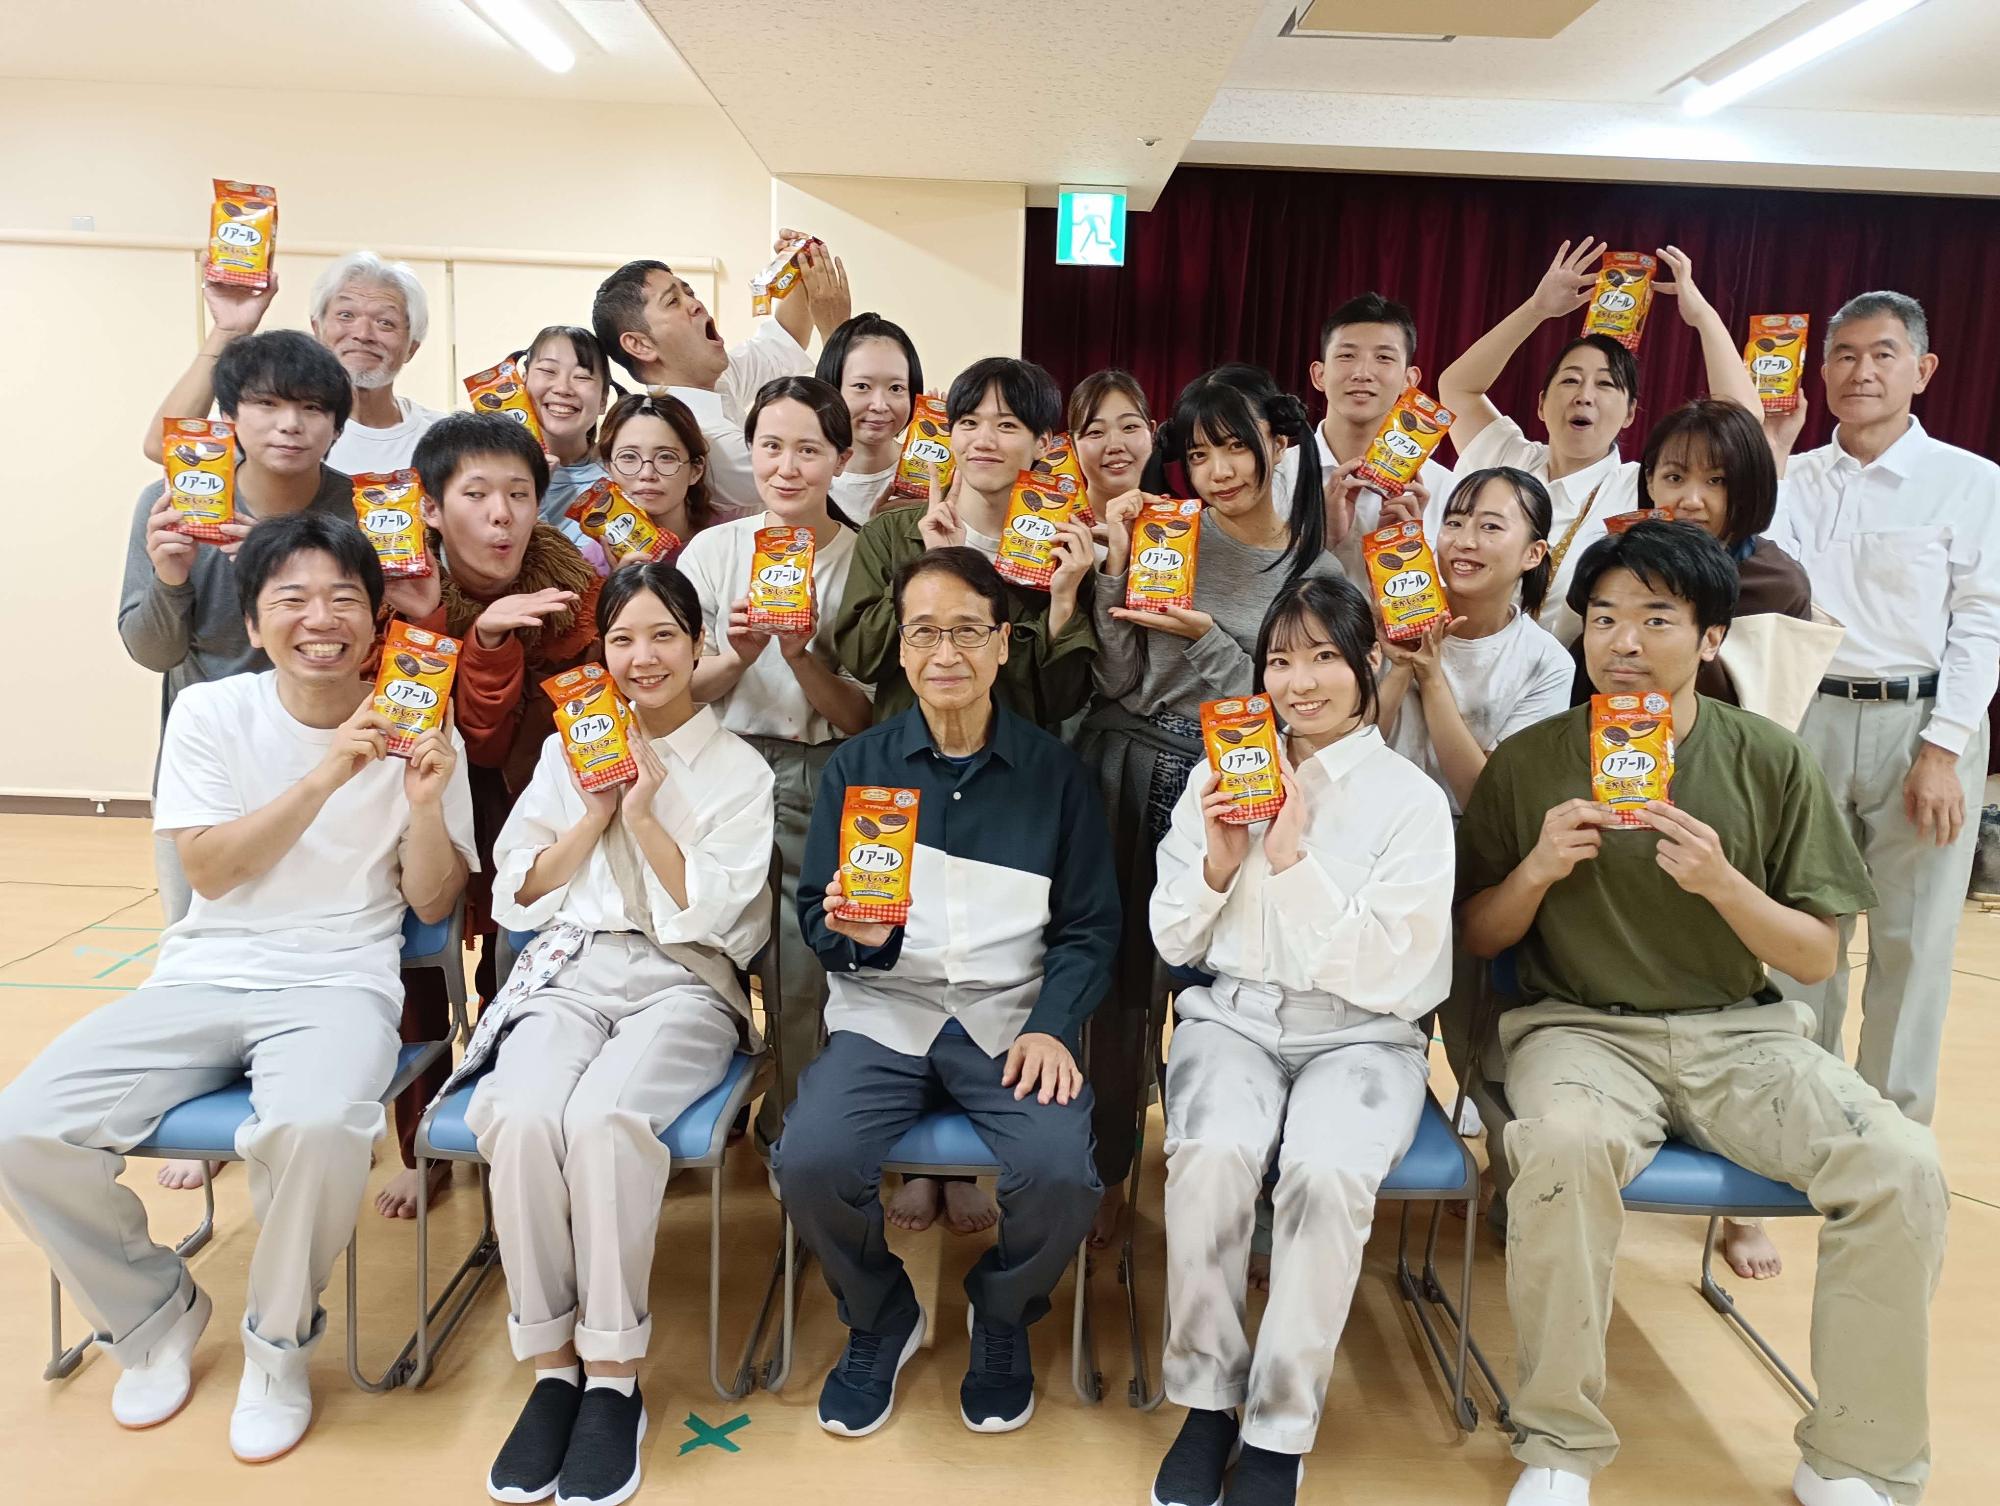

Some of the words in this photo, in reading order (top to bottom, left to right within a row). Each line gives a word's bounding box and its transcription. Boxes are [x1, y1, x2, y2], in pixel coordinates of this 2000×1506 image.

[222, 227, 257, 242] ノアール
[1603, 294, 1633, 308] ノアール
[914, 443, 947, 460] ノアール
[1387, 435, 1418, 456] ノアール
[180, 475, 220, 490] ノアール
[369, 514, 409, 528] ノアール
[1016, 518, 1053, 537] ノアール
[1144, 552, 1180, 566] ノアール
[764, 569, 801, 581] ノアール
[1391, 574, 1427, 594] ノアール
[391, 685, 434, 704] ノアール
[575, 718, 610, 740] ノアール
[1227, 751, 1266, 769] ノアール
[1607, 756, 1651, 772] ノアール
[855, 849, 899, 867] ノアール
